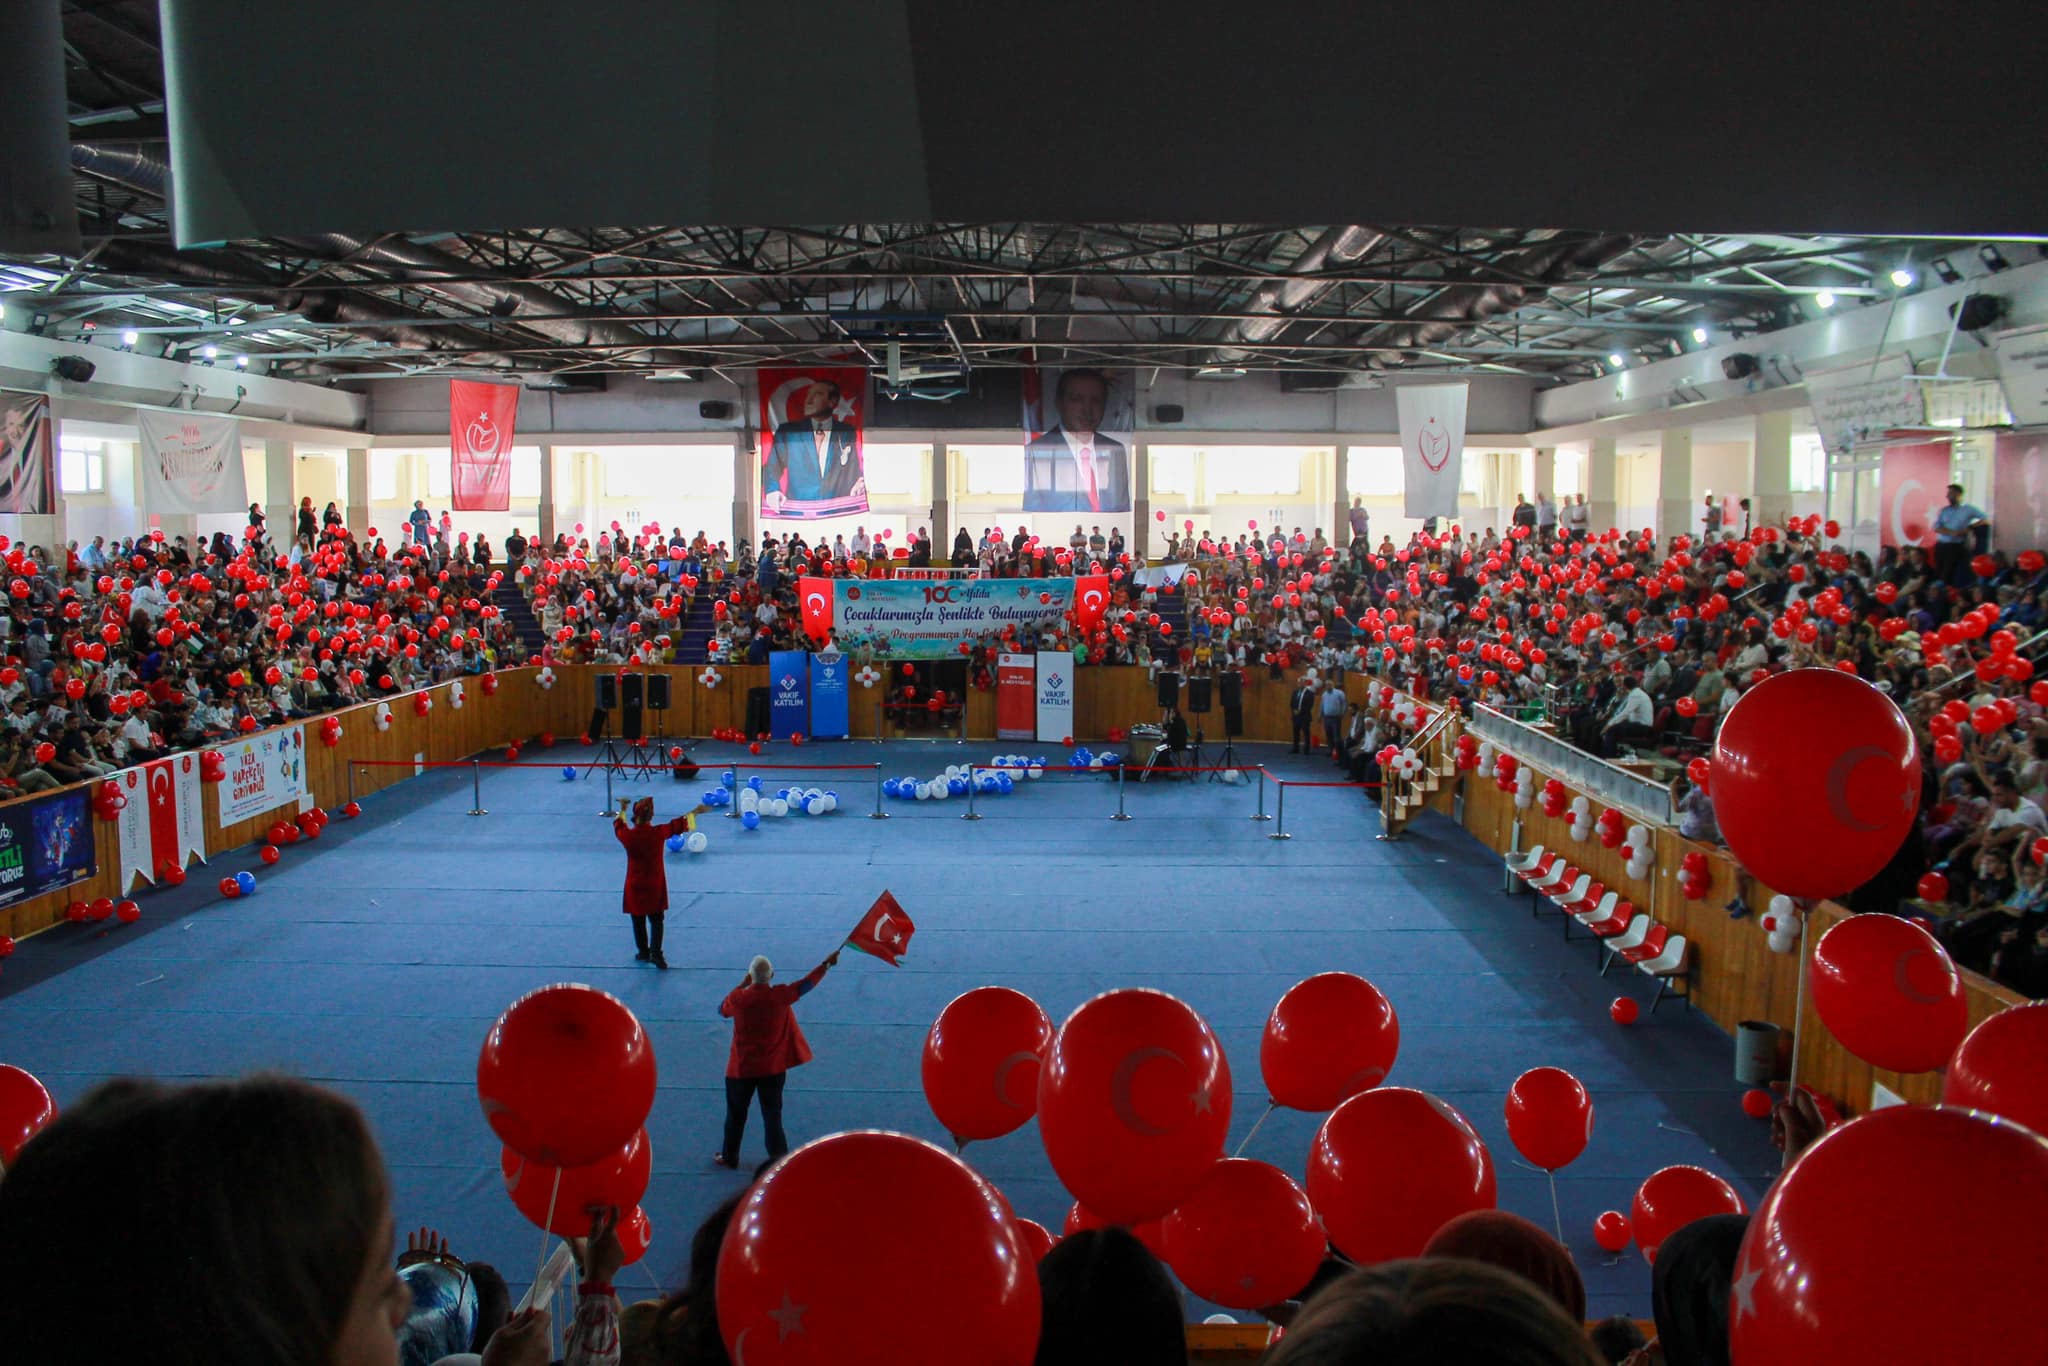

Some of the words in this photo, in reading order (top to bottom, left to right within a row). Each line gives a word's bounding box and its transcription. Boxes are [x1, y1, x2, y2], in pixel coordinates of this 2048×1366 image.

[844, 606, 933, 625] Çocuklarımızla
[938, 606, 985, 624] Şenlikte
[989, 605, 1065, 624] Buluşuyoruz
[891, 627, 960, 642] Programımıza
[778, 691, 800, 699] VAKIF
[1044, 690, 1066, 698] VAKIF
[773, 698, 804, 707] KATILIM
[1040, 697, 1070, 706] KATILIM
[239, 751, 256, 768] YAZA
